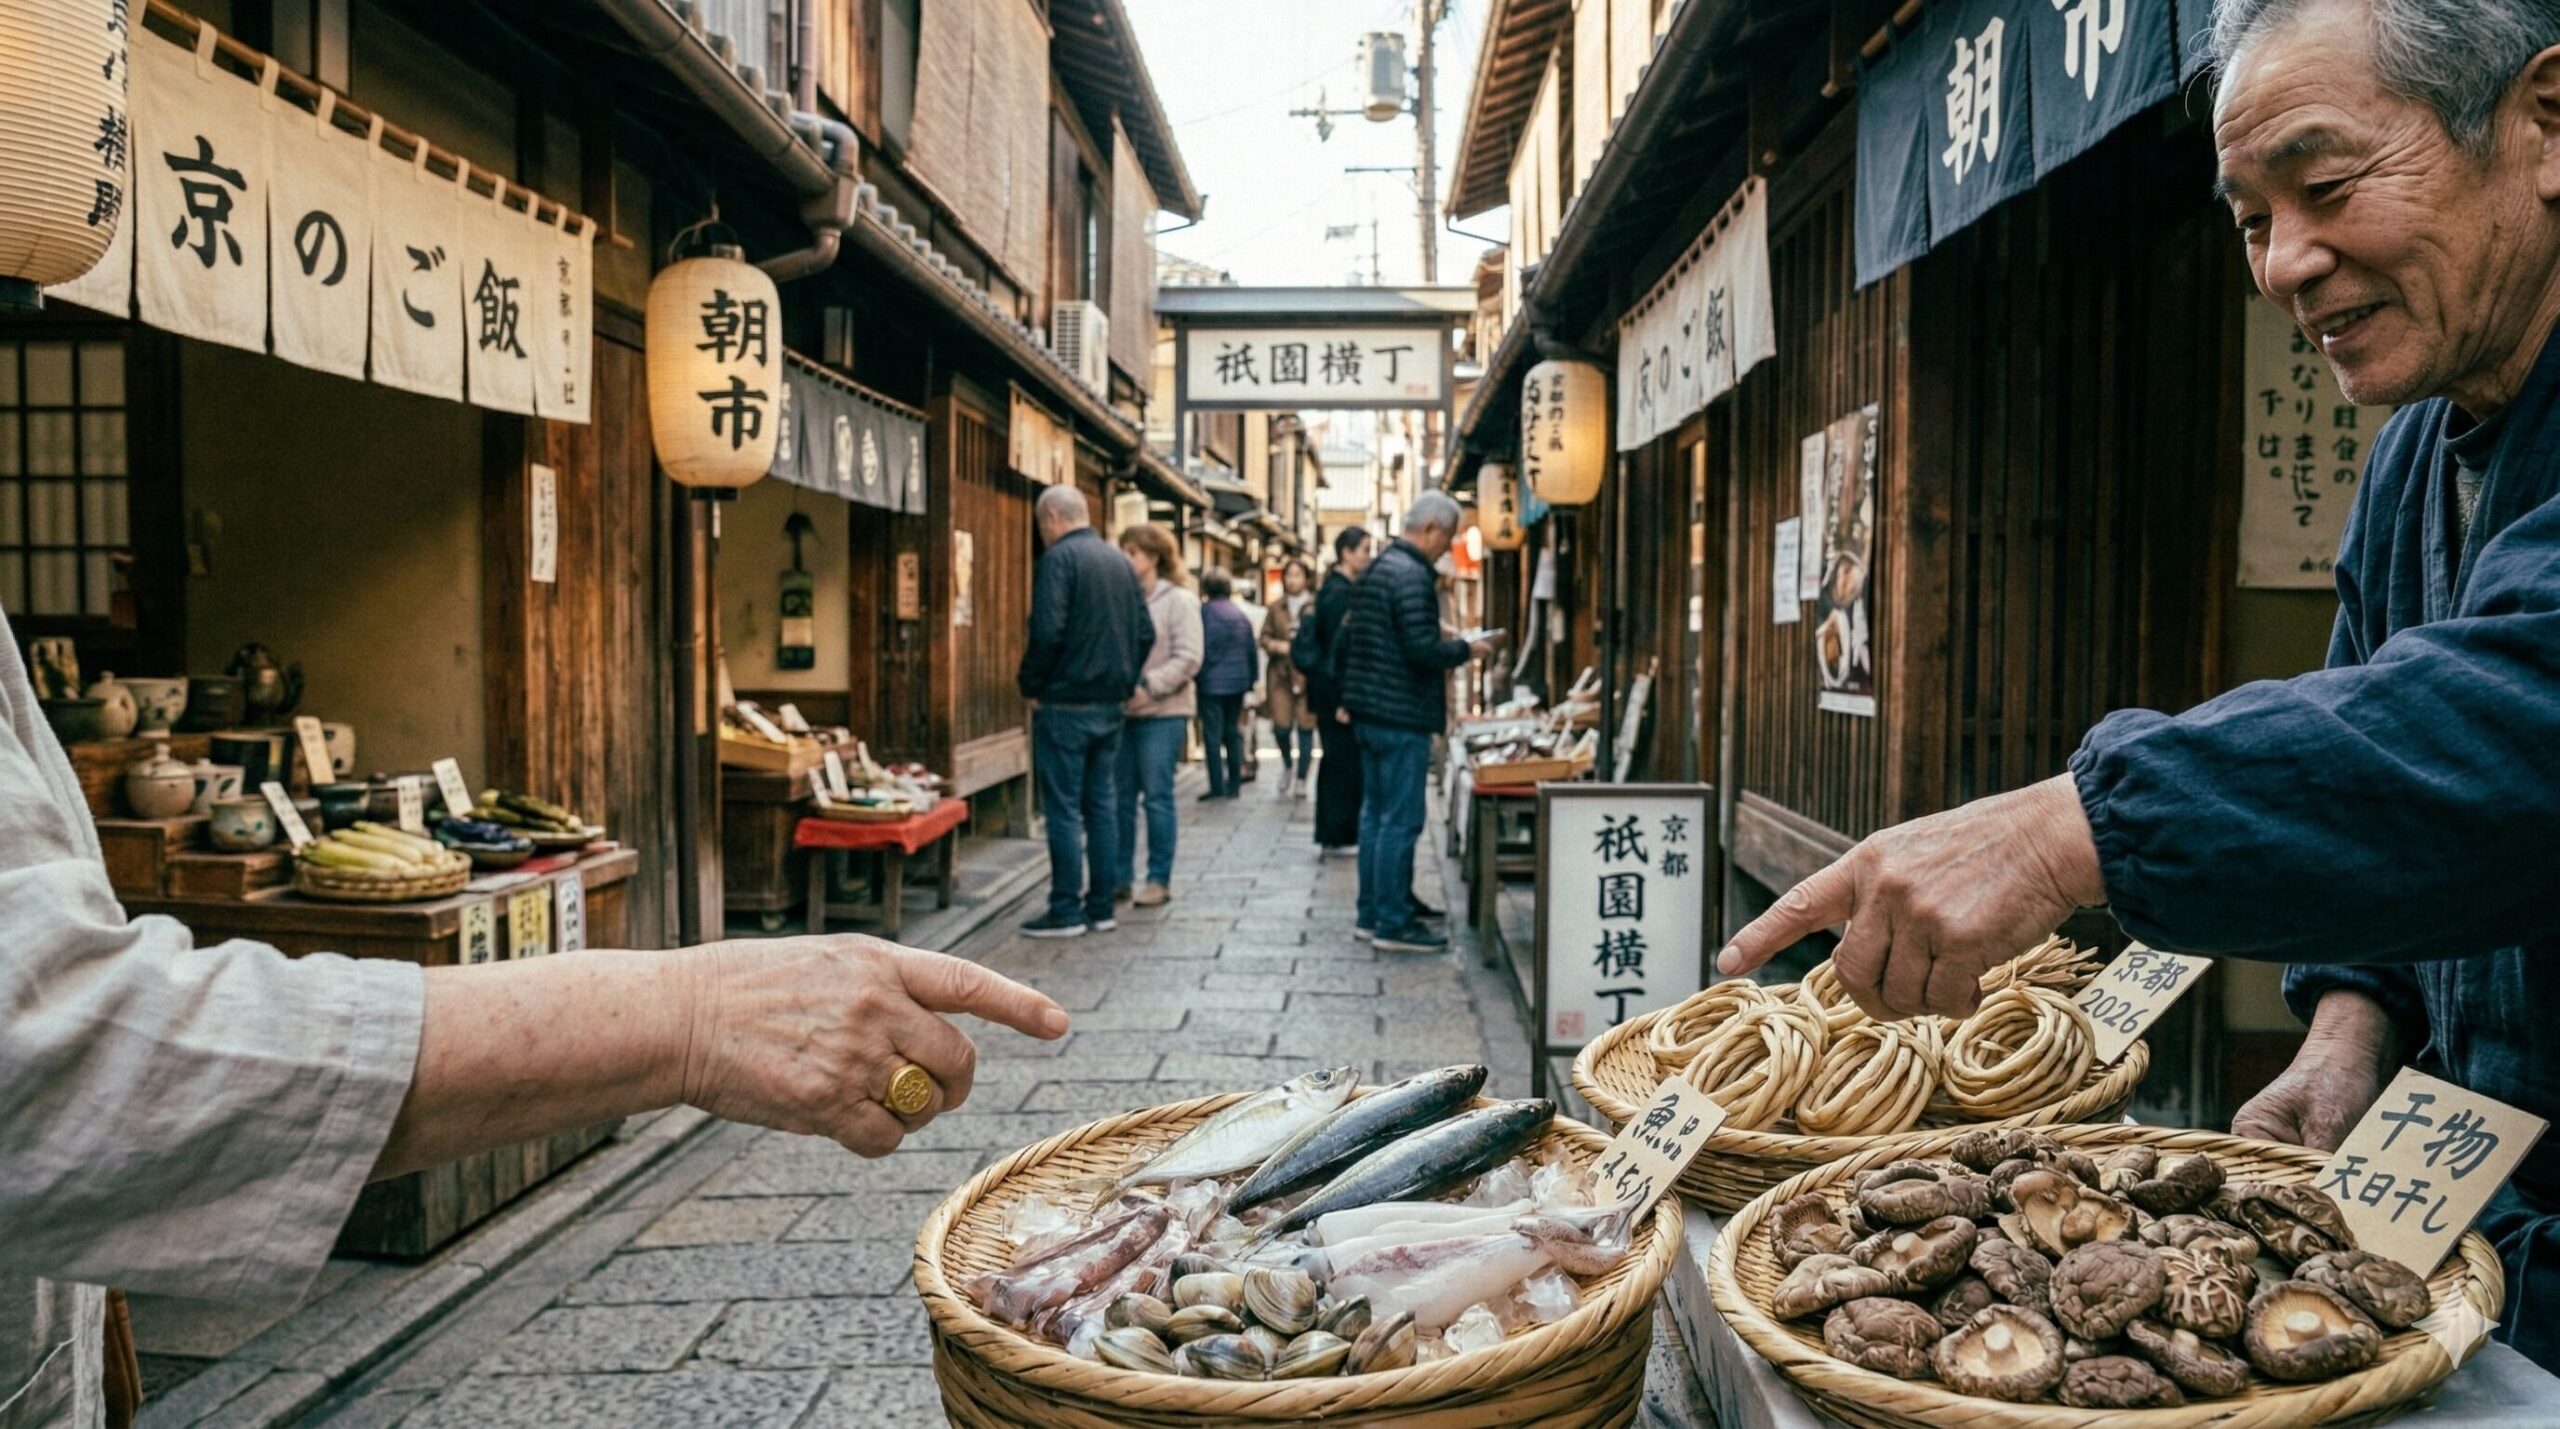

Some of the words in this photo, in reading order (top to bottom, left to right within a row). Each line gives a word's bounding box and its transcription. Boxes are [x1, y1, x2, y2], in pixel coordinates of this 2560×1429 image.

[1942, 0, 2126, 185] 朝市
[163, 135, 527, 360] 京のご飯
[696, 289, 768, 451] 朝市
[1215, 342, 1413, 385] 祇園横丁
[1640, 286, 1726, 415] 京のご飯
[1659, 814, 1689, 878] 京都
[1594, 814, 1649, 1027] 祇園横丁
[2079, 988, 2150, 1035] 2026
[2114, 947, 2189, 998] 京都
[2381, 1092, 2499, 1182] 干物
[2319, 1156, 2450, 1235] 天日干し
